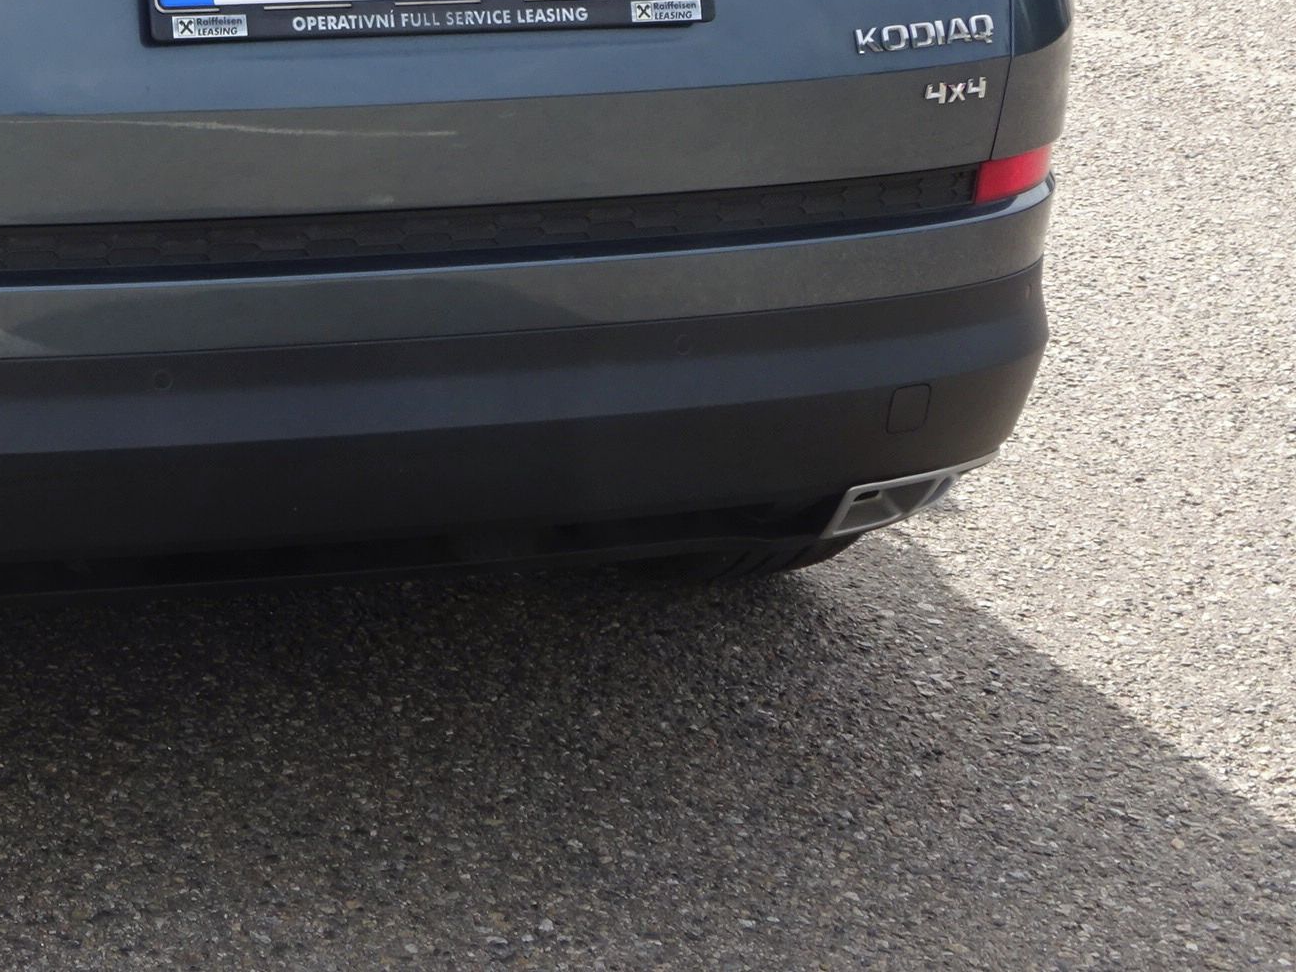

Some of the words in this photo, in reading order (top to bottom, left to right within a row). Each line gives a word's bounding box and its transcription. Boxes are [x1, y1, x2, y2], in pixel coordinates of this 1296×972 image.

[653, 1, 697, 11] Raiffeisen
[196, 15, 243, 27] Raiffeisen
[292, 9, 396, 31] OPERATIVNÍ
[401, 12, 440, 28] FULL
[446, 9, 511, 26] SERVICE
[517, 7, 588, 24] LEASING
[654, 11, 693, 21] LEASING
[198, 26, 239, 36] LEASING
[855, 14, 995, 55] KODIAQ
